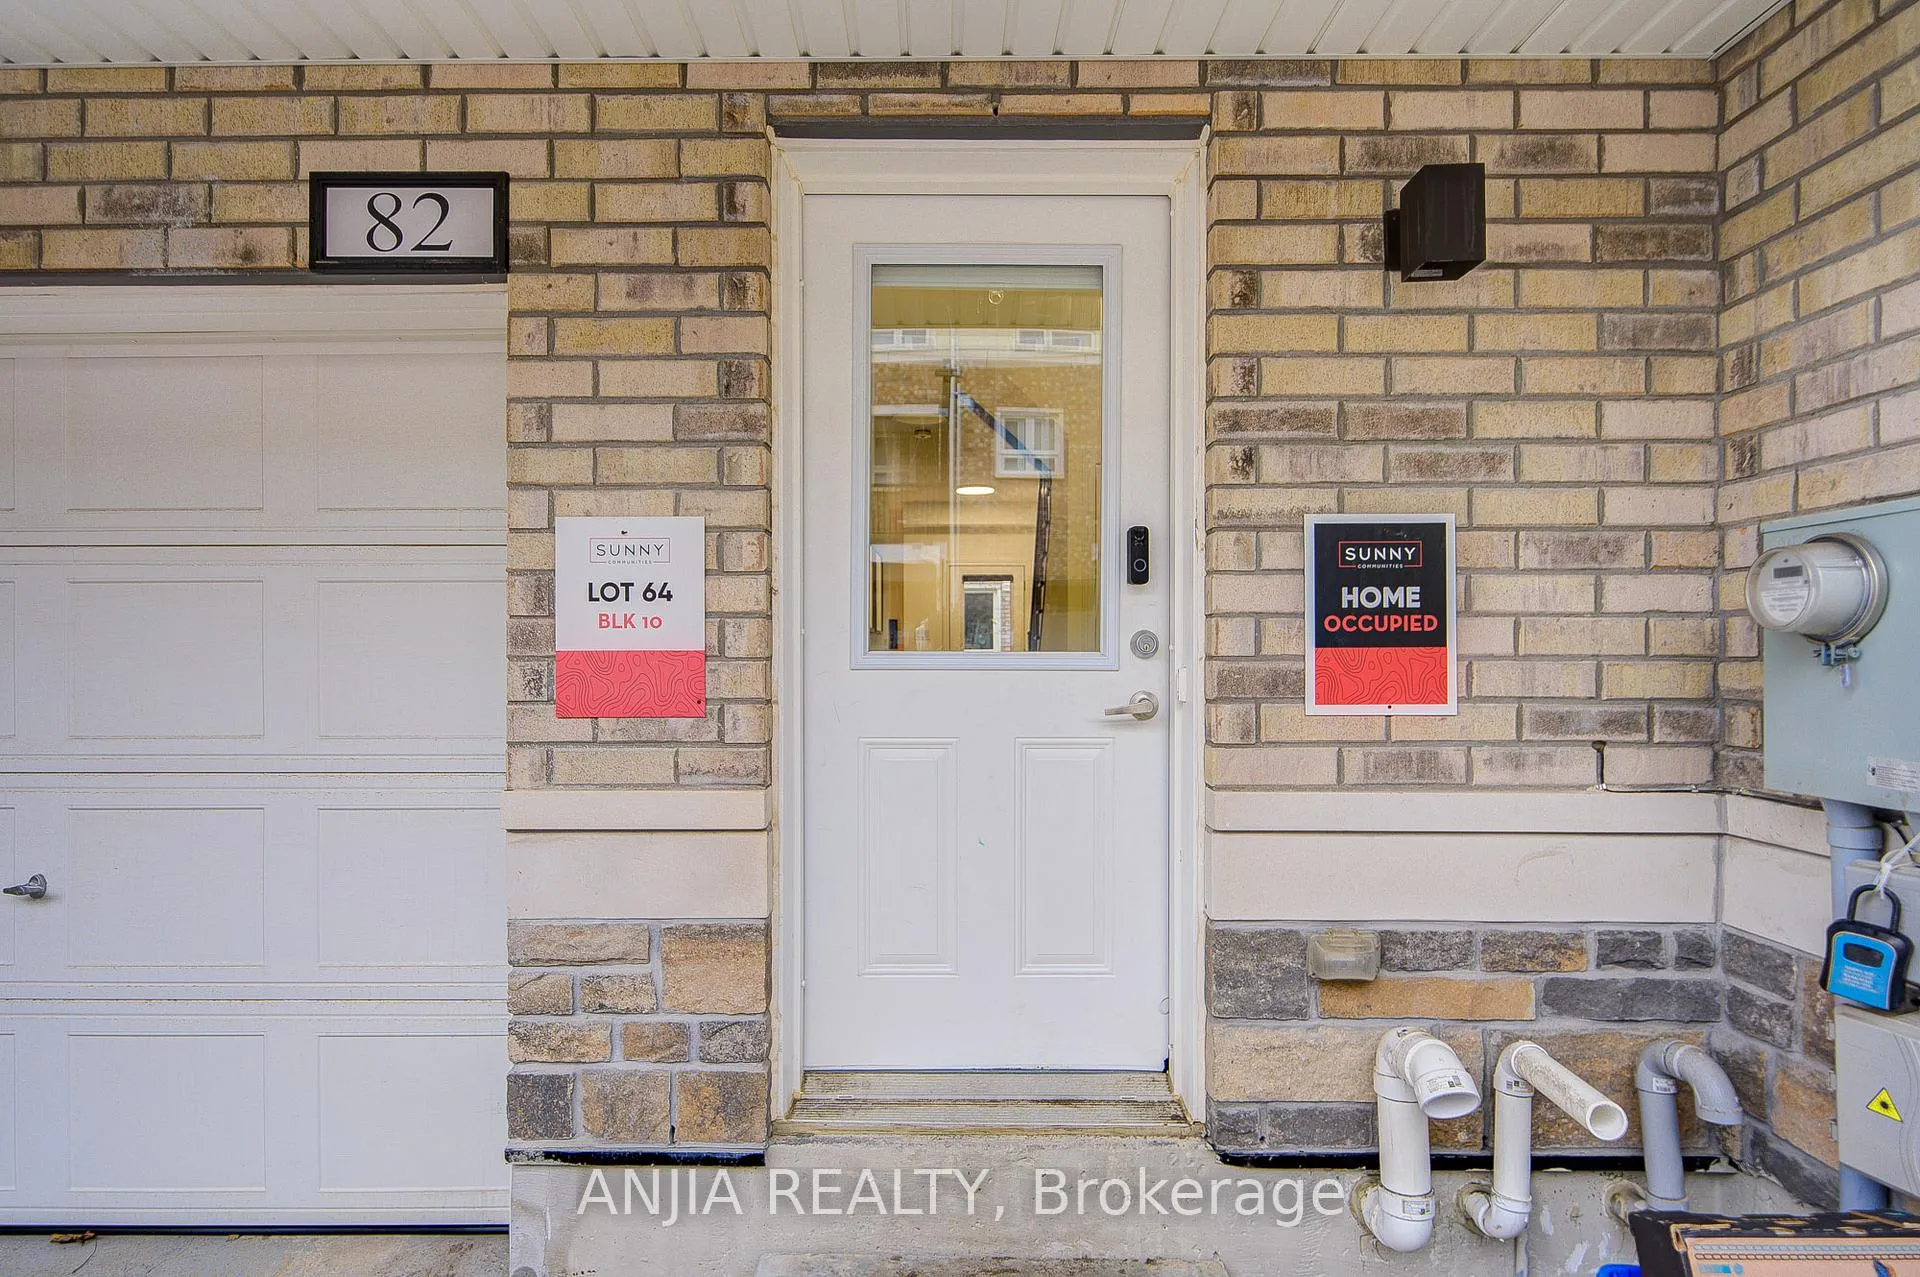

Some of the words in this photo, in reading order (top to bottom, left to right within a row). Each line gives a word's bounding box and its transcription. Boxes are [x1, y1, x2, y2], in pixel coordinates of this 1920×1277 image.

[366, 192, 453, 252] 82
[596, 543, 664, 557] SUNNY
[1345, 547, 1416, 561] SUNNY
[588, 582, 635, 602] LOT
[642, 582, 673, 602] 64
[1341, 586, 1421, 609] HOME
[598, 613, 636, 629] BLK
[642, 616, 663, 629] 10
[1323, 614, 1438, 632] OCCUPIED
